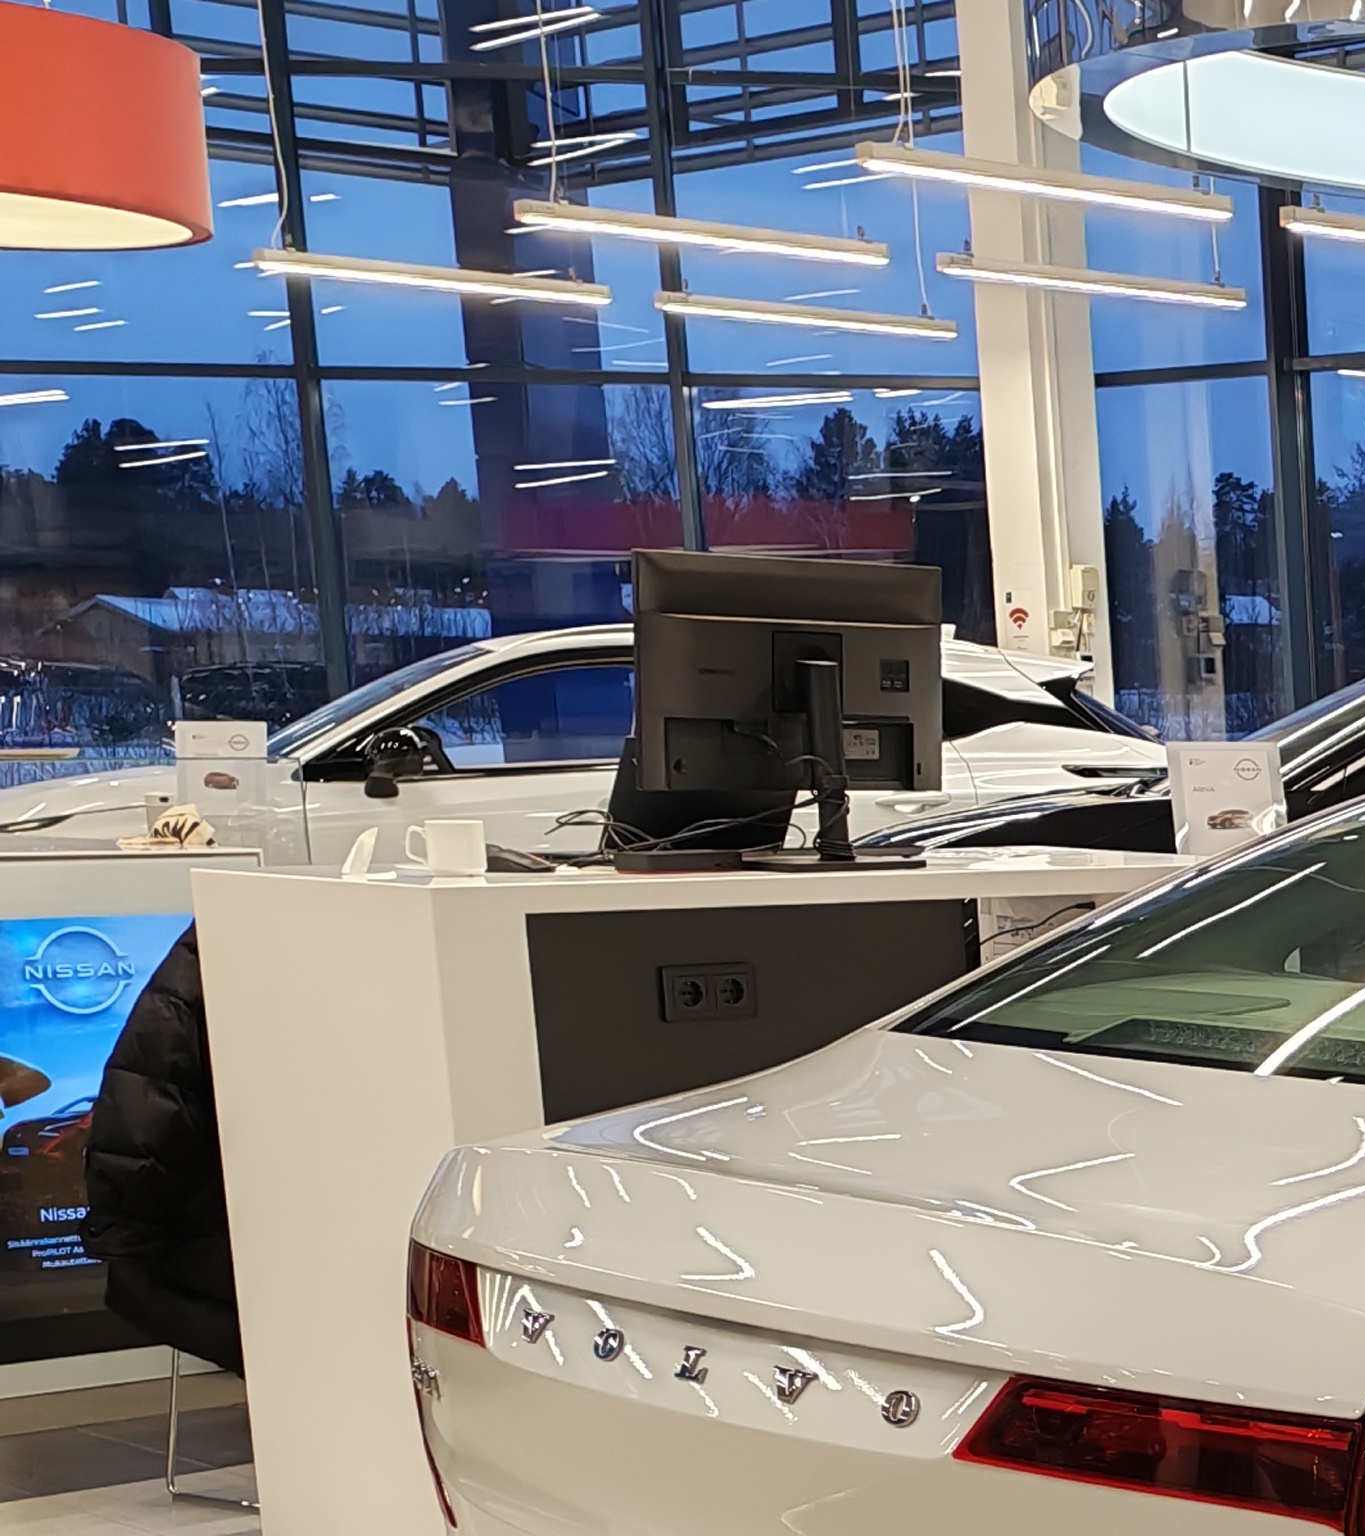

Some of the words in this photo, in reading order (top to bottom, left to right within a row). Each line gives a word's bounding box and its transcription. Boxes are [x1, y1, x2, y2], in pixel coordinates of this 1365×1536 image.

[24, 961, 135, 980] NISSAN
[41, 1207, 91, 1222] Nissa
[521, 1308, 921, 1429] VOLVO
